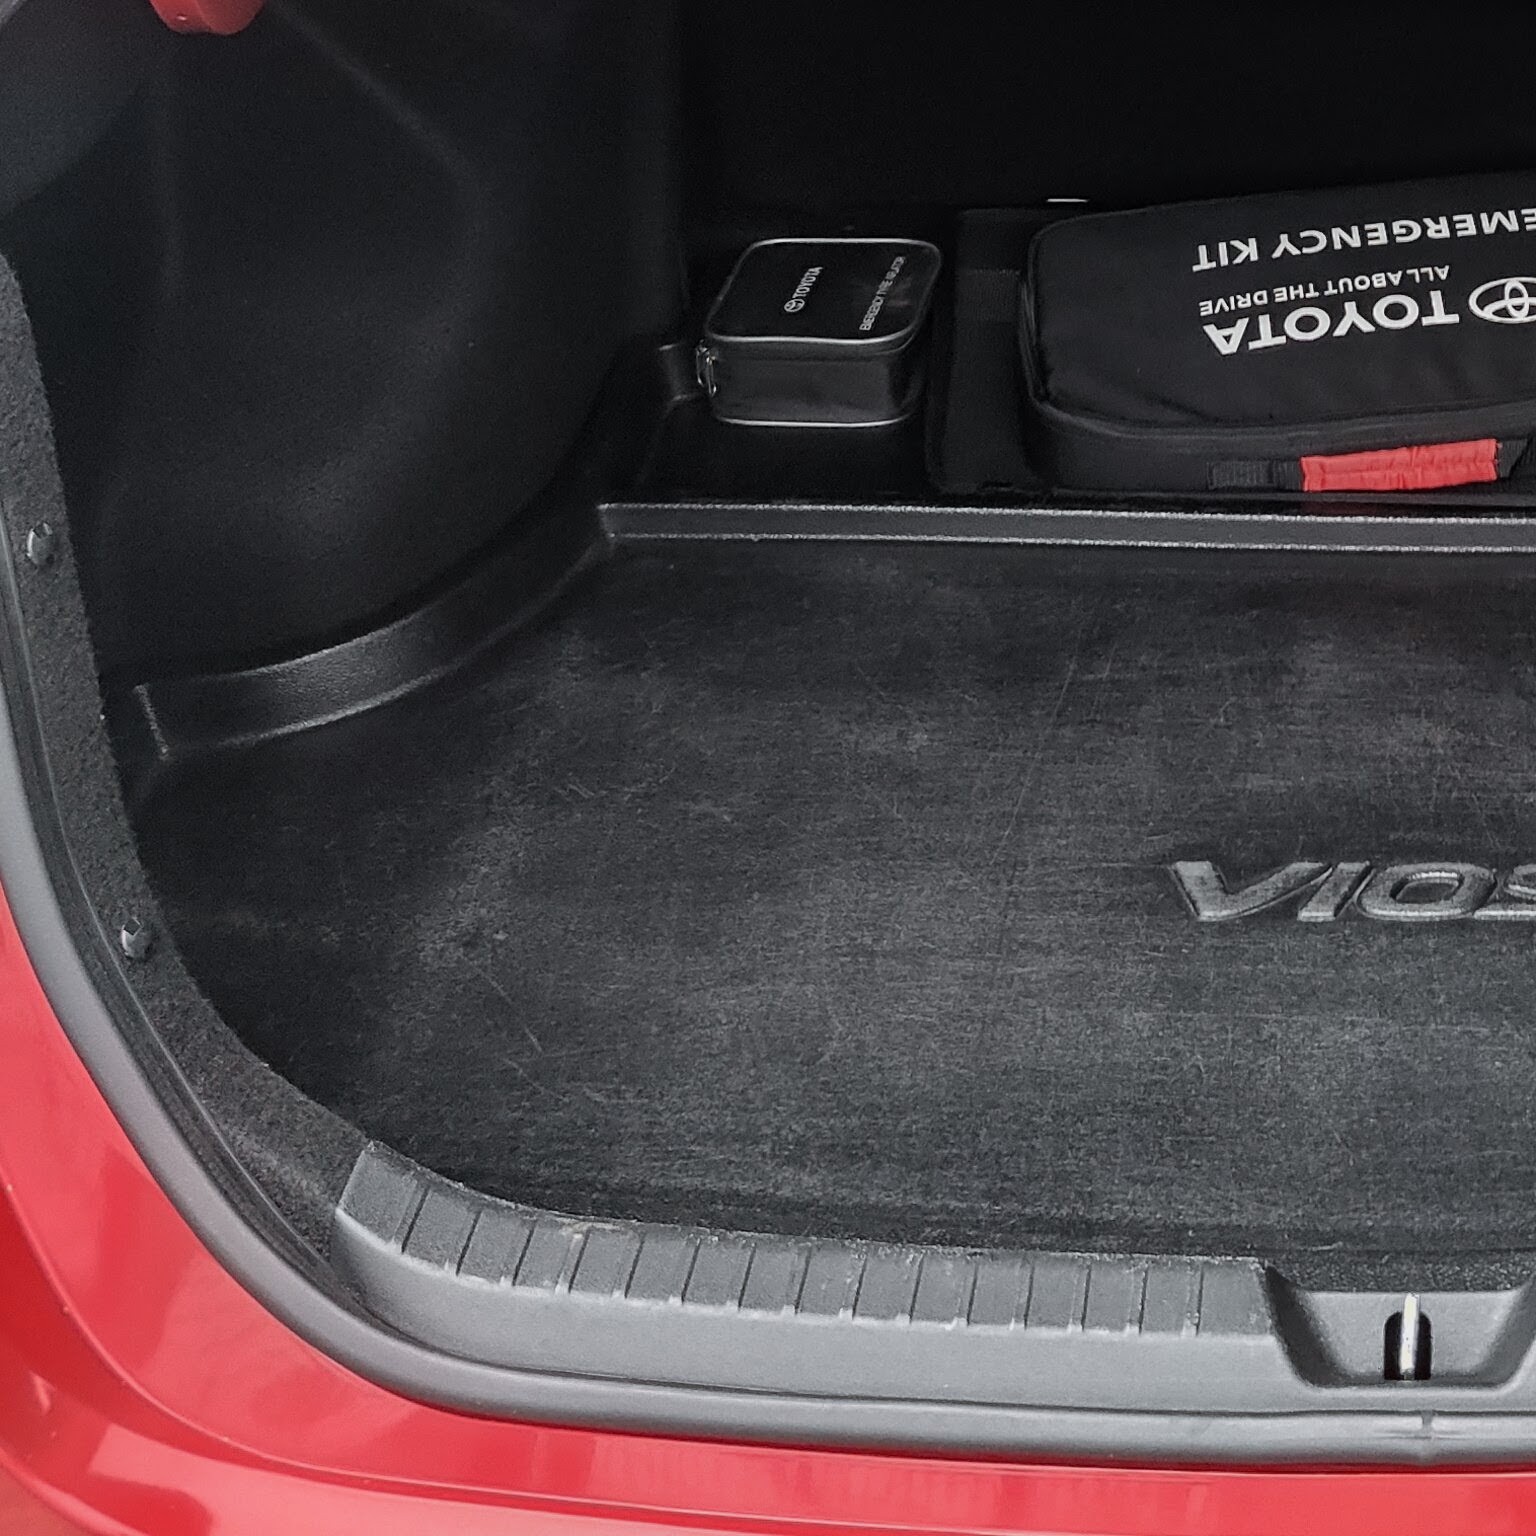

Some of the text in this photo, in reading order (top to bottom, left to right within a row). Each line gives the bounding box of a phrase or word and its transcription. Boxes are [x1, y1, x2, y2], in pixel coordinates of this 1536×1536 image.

[1192, 237, 1260, 272] KIT
[792, 266, 823, 299] TOYOTA
[1199, 265, 1451, 317] ALL ABOUT THE DRIVE
[1202, 289, 1460, 356] TOYOTA
